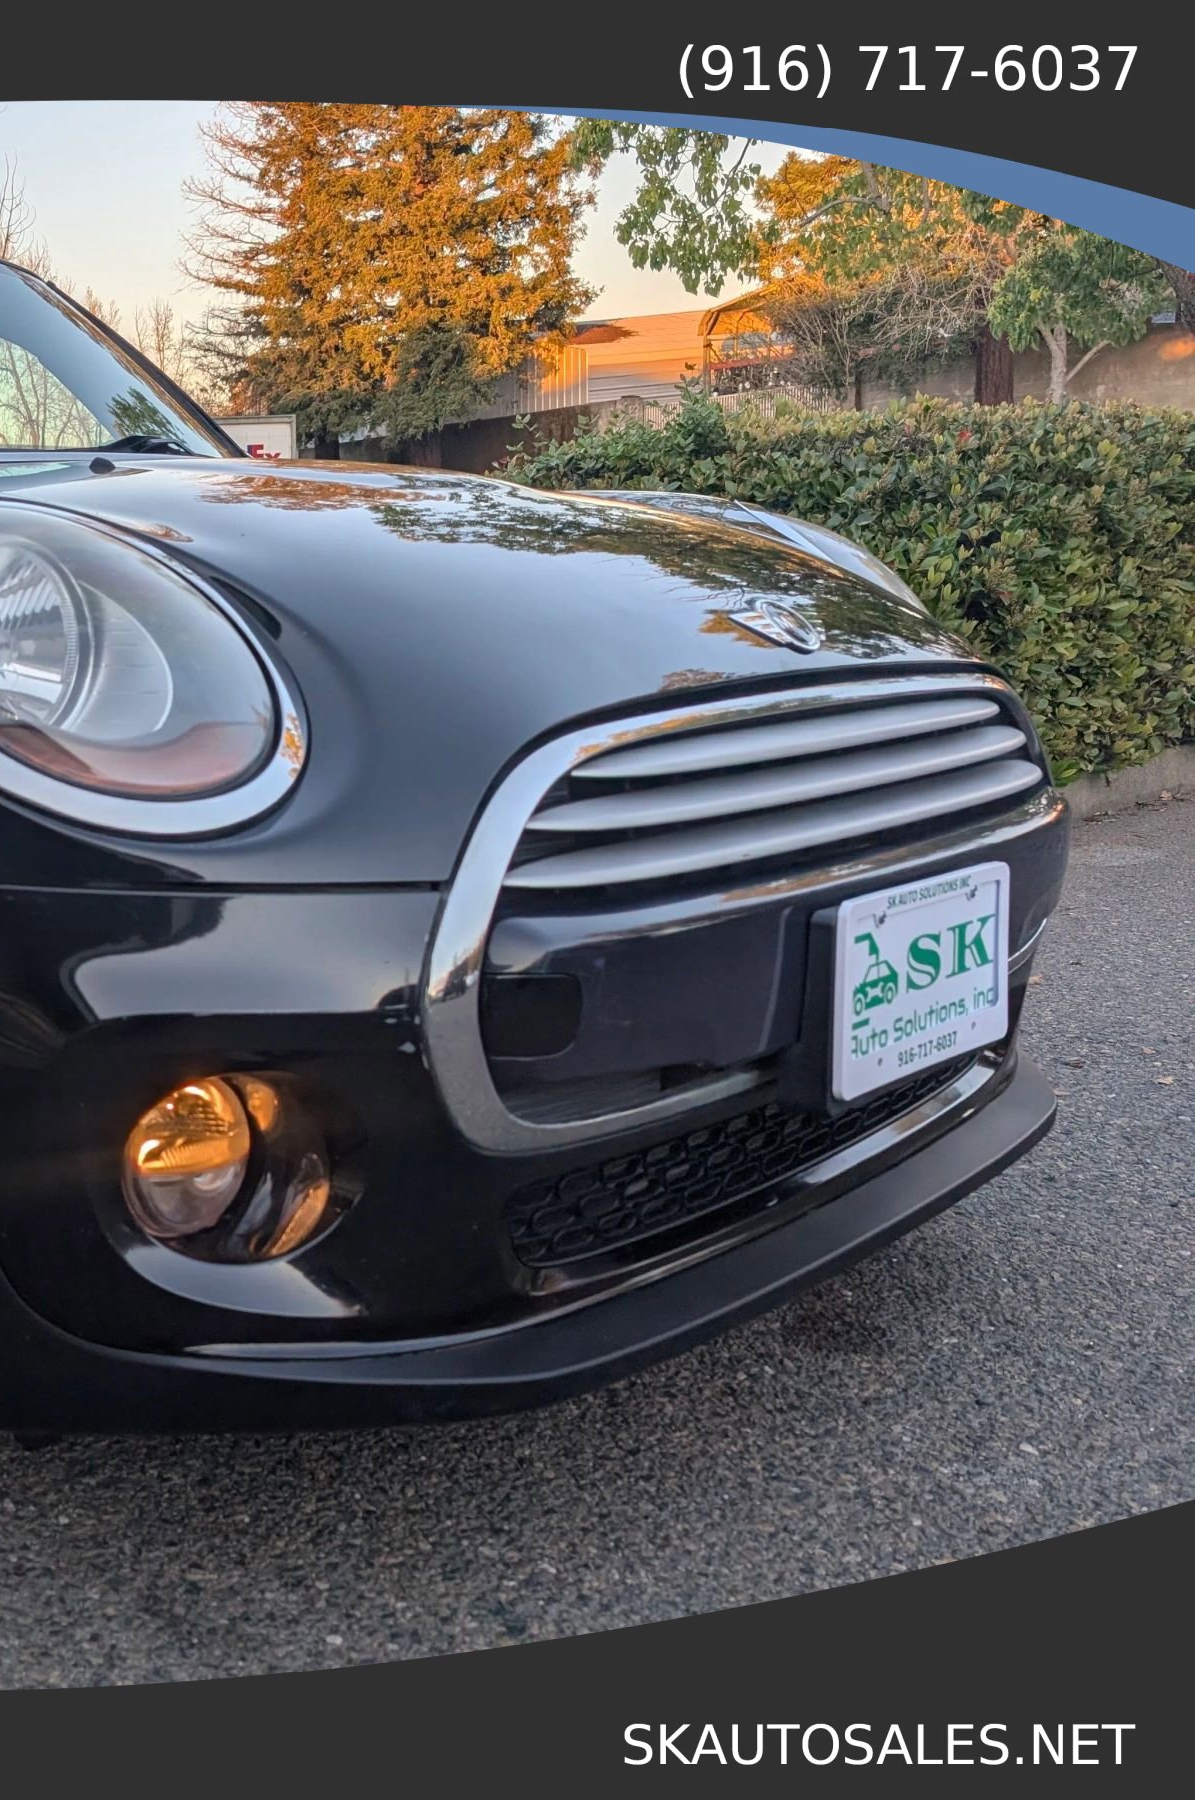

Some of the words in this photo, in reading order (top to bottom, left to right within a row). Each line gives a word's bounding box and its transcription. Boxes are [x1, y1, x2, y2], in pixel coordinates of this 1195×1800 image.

[887, 894, 897, 910] SK
[898, 890, 918, 905] AUTO
[919, 878, 958, 901] SOLUTIONS
[959, 875, 972, 889] INC
[906, 913, 996, 994] SK
[893, 998, 969, 1042] Solutions,
[973, 987, 996, 1010] inc
[897, 1031, 957, 1067] 916-717-6037
